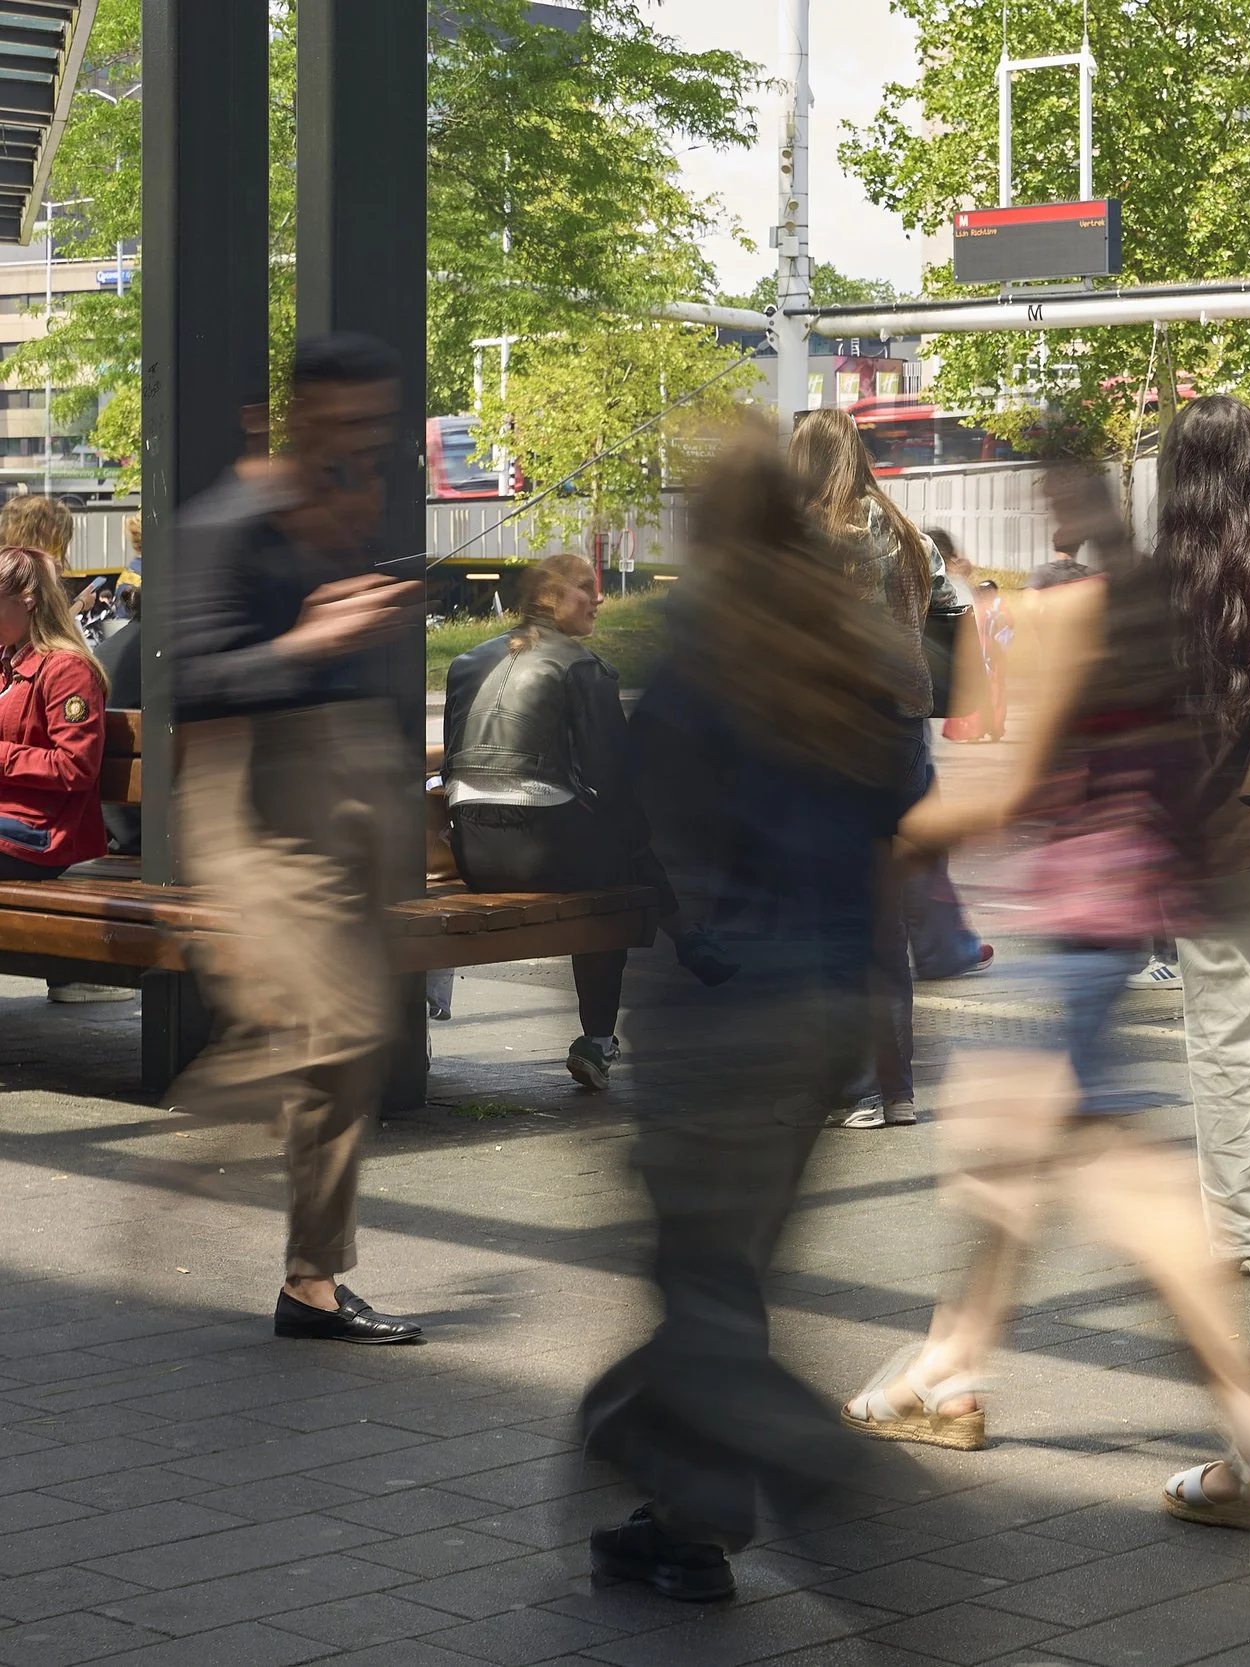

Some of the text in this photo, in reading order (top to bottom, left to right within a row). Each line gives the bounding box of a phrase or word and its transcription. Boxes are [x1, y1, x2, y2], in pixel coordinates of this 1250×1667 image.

[955, 219, 1106, 238] Lijn Richting Vertrek
[959, 215, 969, 227] M
[1028, 304, 1043, 321] M
